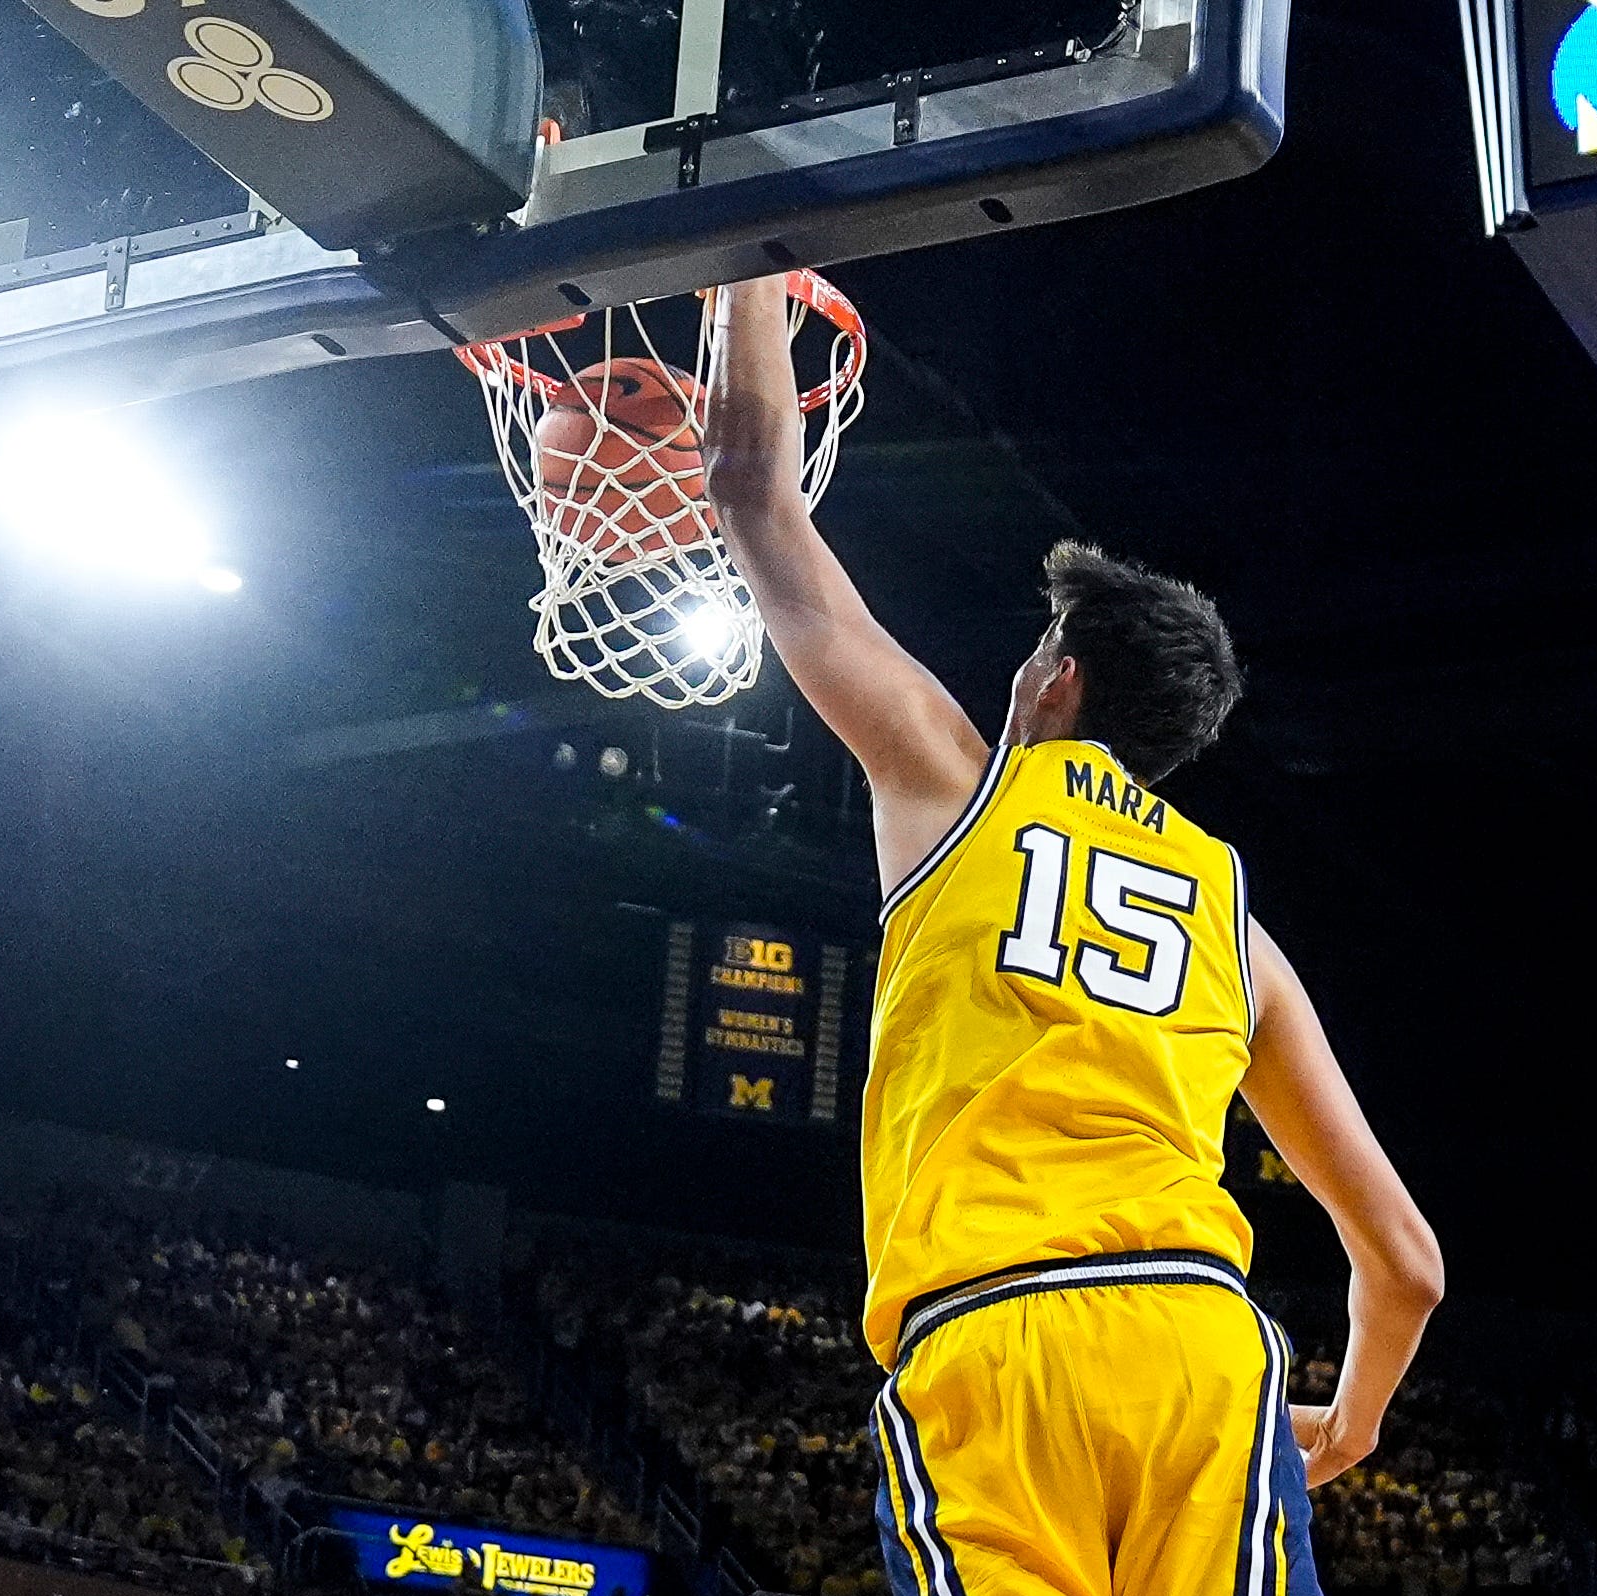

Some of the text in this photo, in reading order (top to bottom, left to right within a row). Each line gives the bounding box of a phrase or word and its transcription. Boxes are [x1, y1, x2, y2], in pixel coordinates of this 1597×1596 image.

[1064, 759, 1167, 835] MARA
[995, 821, 1199, 1017] 15
[729, 1073, 775, 1111] M
